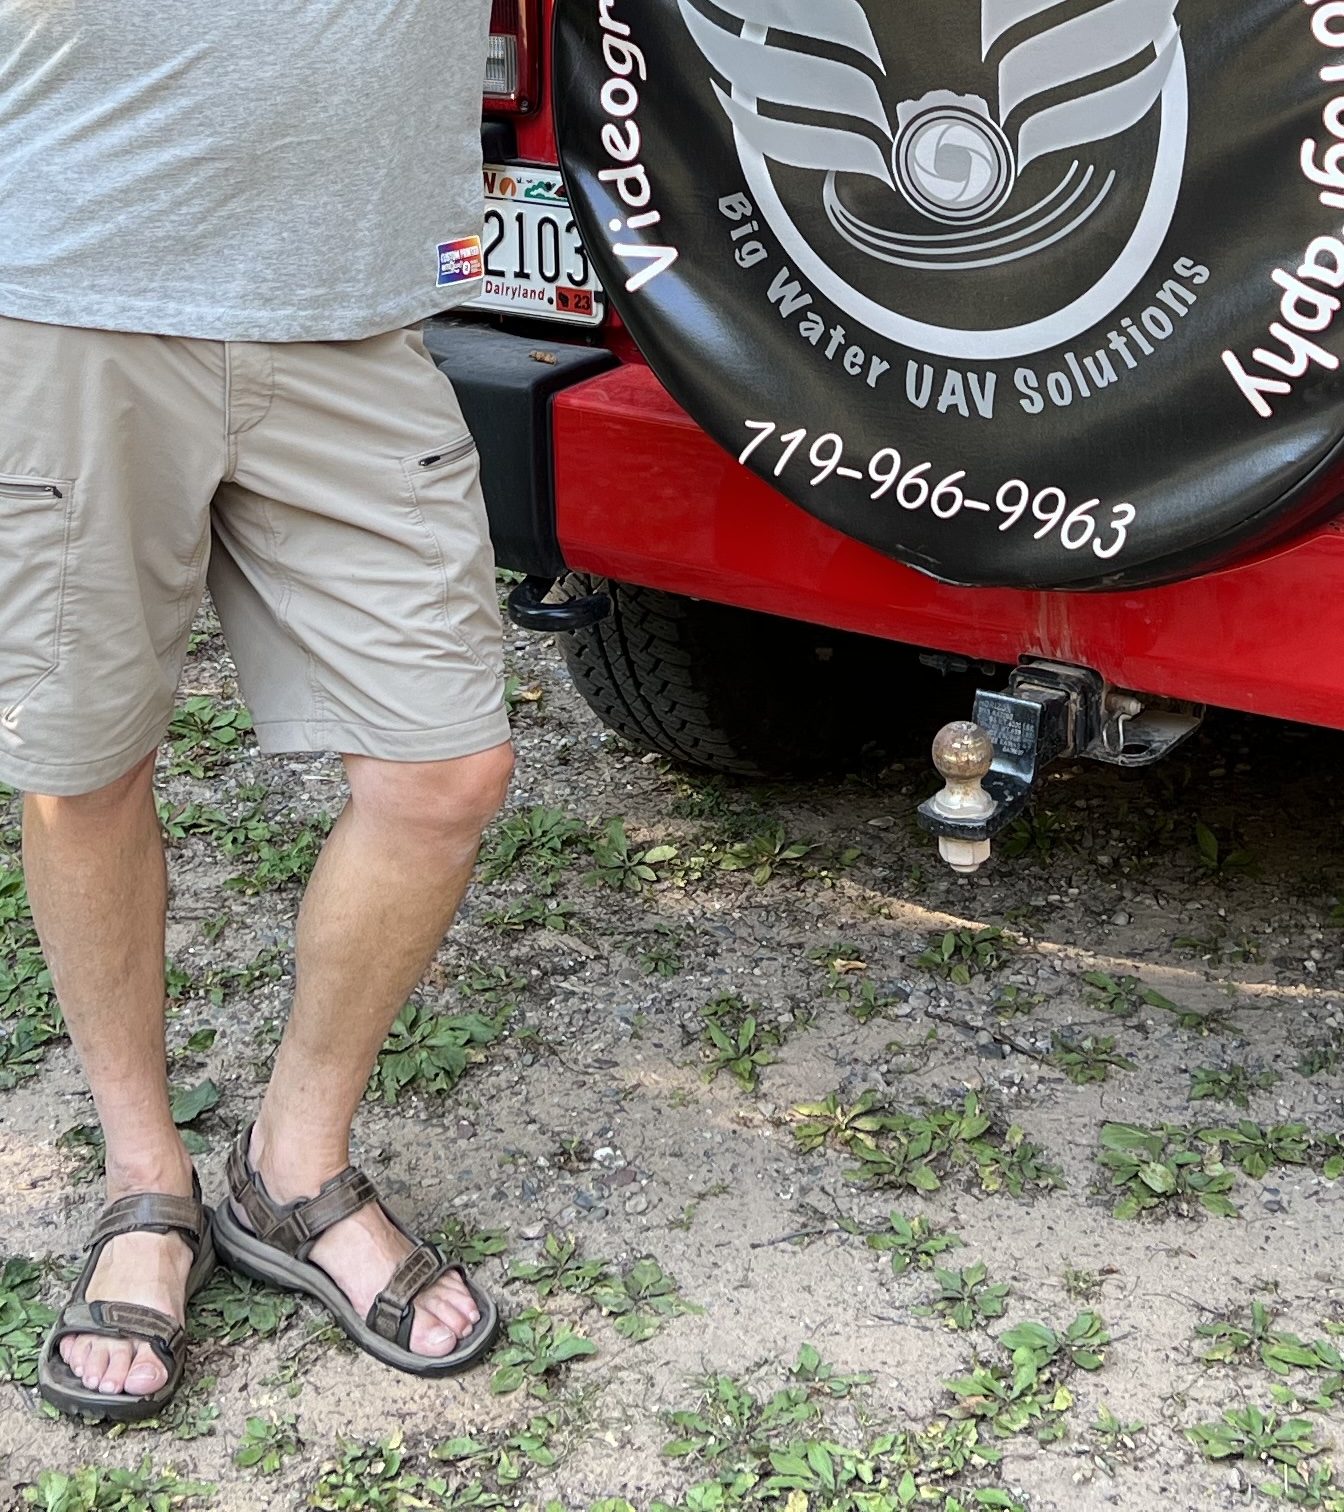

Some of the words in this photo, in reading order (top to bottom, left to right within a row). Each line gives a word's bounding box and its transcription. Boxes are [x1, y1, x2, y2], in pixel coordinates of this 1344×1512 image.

[484, 281, 546, 301] Dairyland
[573, 294, 591, 310] 23
[717, 191, 764, 269] Big
[765, 270, 892, 389] Water
[904, 359, 998, 420] UAV
[1013, 257, 1211, 415] Solutions
[737, 418, 1137, 560] 719-966-9963
